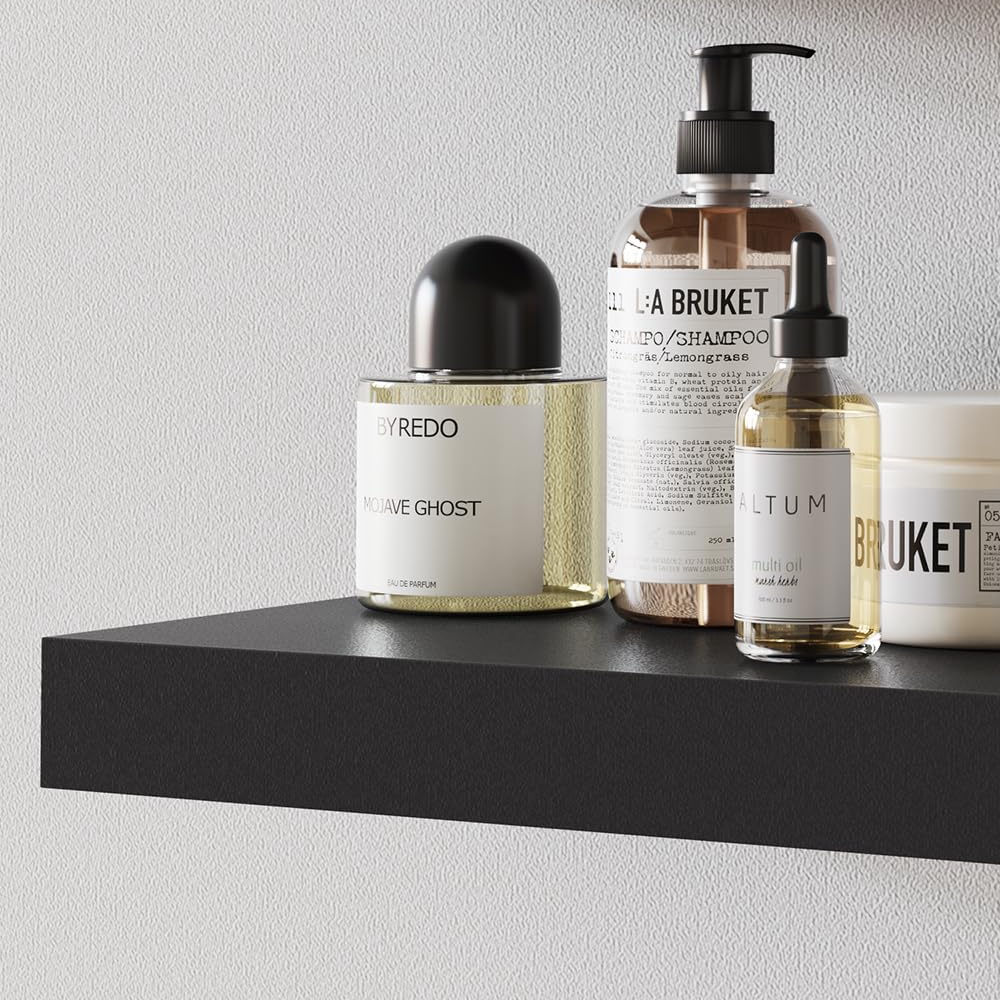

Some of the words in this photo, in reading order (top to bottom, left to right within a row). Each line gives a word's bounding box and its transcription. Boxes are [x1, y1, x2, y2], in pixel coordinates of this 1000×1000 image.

[636, 288, 664, 315] L:A
[672, 288, 769, 316] BRUKET
[720, 370, 742, 378] oily
[725, 392, 744, 400] scal
[708, 408, 737, 416] ingred
[377, 416, 459, 438] BYREDO
[364, 496, 410, 515] MOJAVE
[414, 500, 482, 517] GHOST
[739, 492, 826, 515] ALTUM
[708, 536, 723, 544] 250
[752, 556, 782, 572] multi
[786, 556, 802, 572] oil
[399, 580, 408, 588] DE
[409, 580, 437, 589] PARFUM
